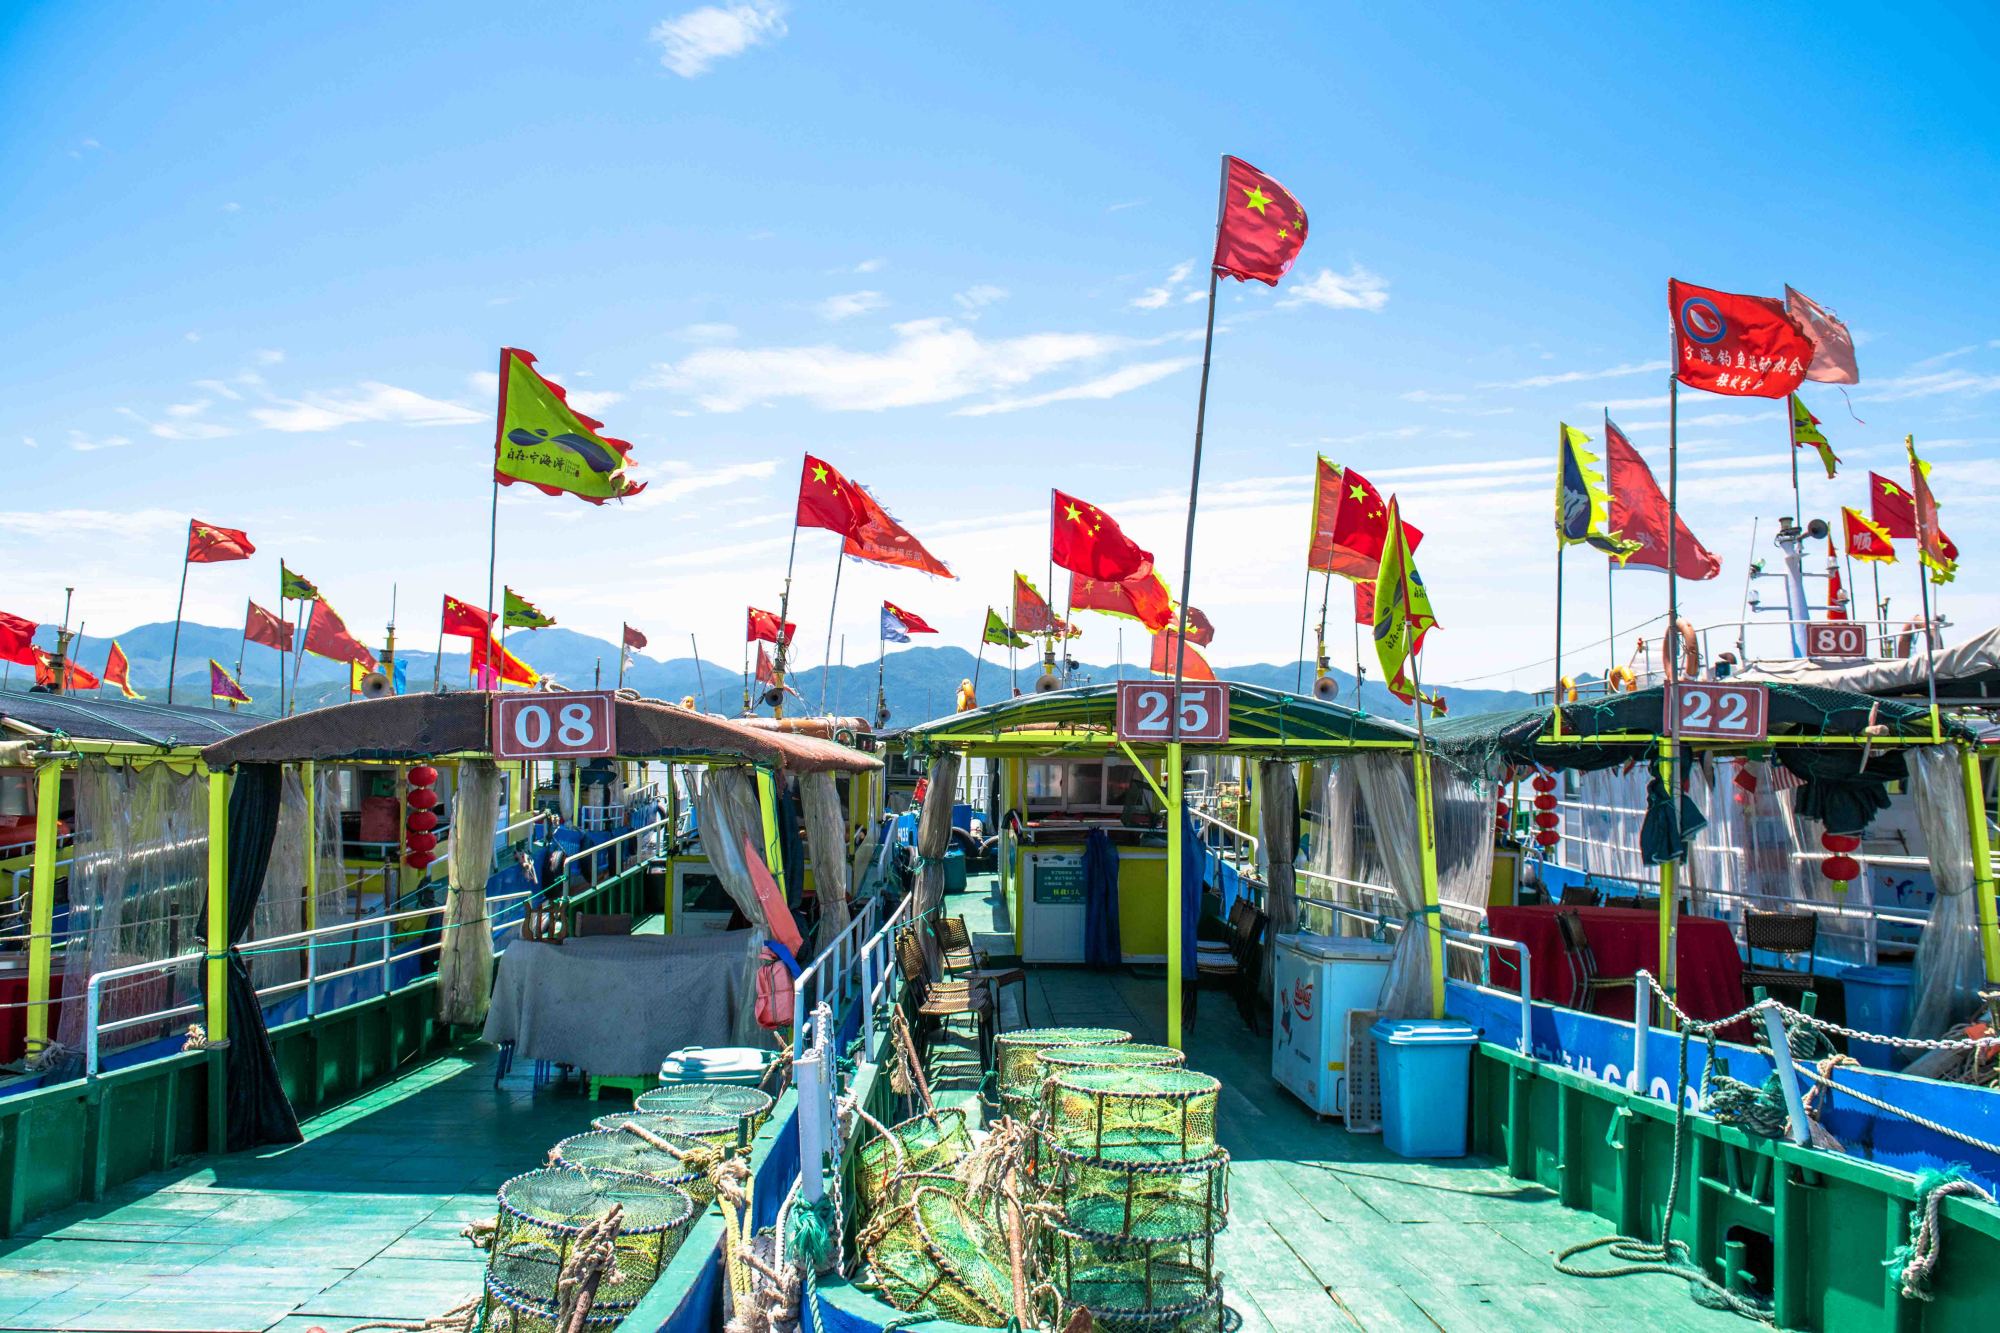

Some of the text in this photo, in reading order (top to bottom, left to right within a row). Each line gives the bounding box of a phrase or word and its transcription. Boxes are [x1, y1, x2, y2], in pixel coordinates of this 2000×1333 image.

[1853, 531, 1873, 552] 顺
[1817, 629, 1858, 652] 80
[515, 703, 594, 748] 08
[1137, 690, 1209, 732] 25
[1682, 690, 1748, 730] 22
